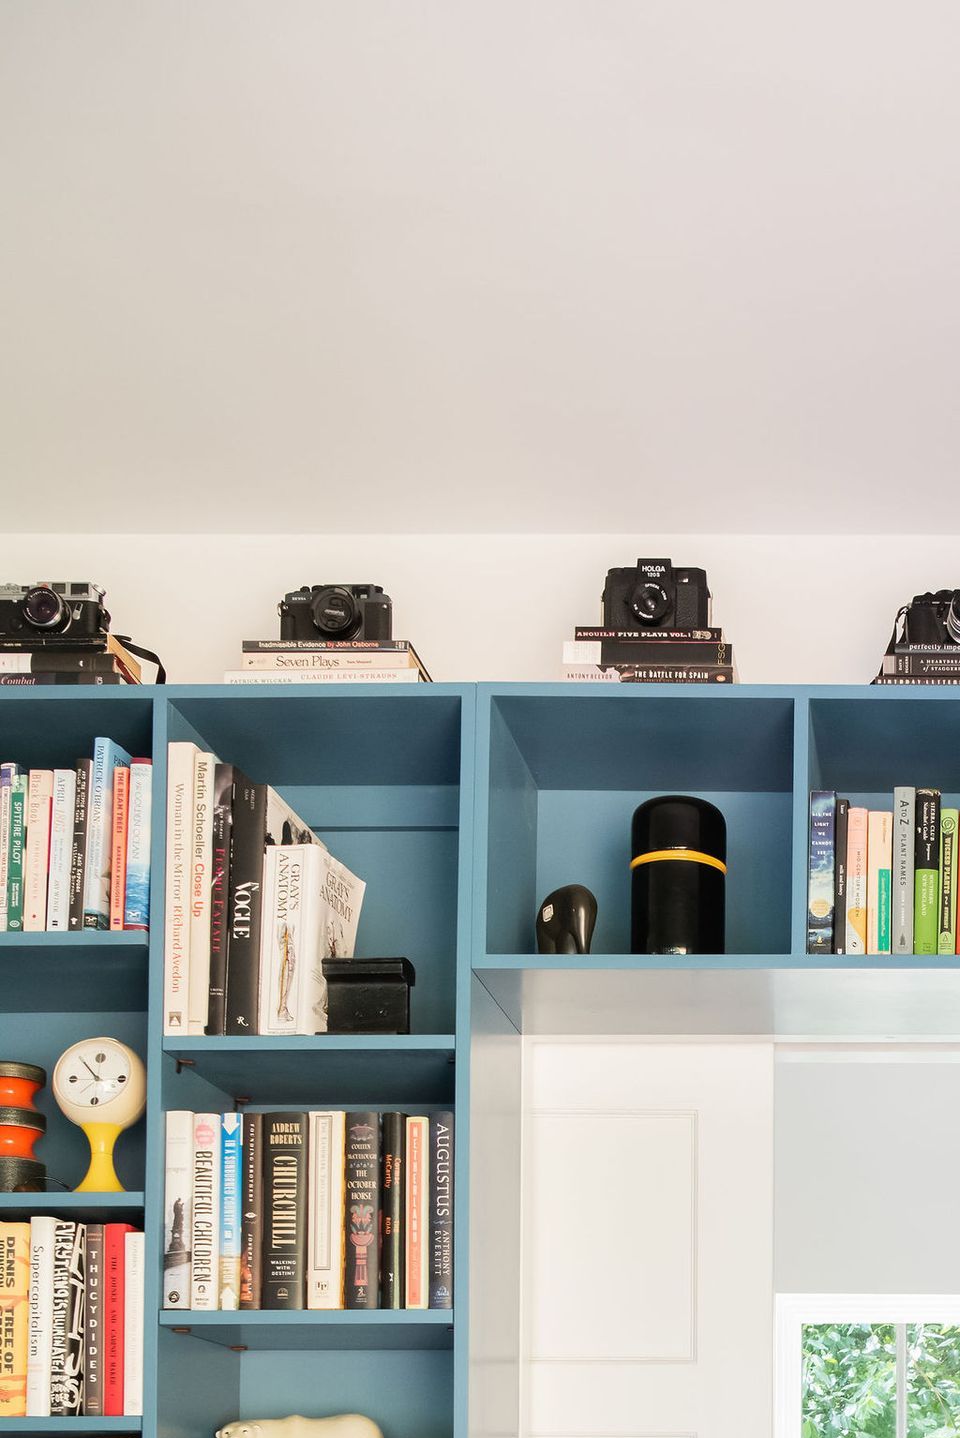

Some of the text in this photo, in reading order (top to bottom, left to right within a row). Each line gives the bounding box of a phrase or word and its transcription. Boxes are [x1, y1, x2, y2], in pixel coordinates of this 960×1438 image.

[276, 656, 339, 669] Seven Plays
[649, 670, 672, 679] BATTLE
[93, 745, 104, 822] PATRICK O'BRIAN
[13, 802, 22, 864] SPITFIRE PILOT
[193, 762, 207, 918] Martin Schoeller Close Up
[172, 784, 184, 993] Woman in the Mirror Richard Avedon
[232, 882, 260, 939] IN VOGUE
[277, 854, 300, 922] GRAY'S ANATOMY
[272, 1156, 297, 1248] CHURCHILL
[436, 1123, 449, 1216] AUGUSTUS
[194, 1151, 212, 1282] BEAUTIFUL CHILDREN
[7, 1236, 15, 1288] DENIS
[31, 1246, 43, 1356] Supercapitalism
[5, 1307, 14, 1374] TREE OF
